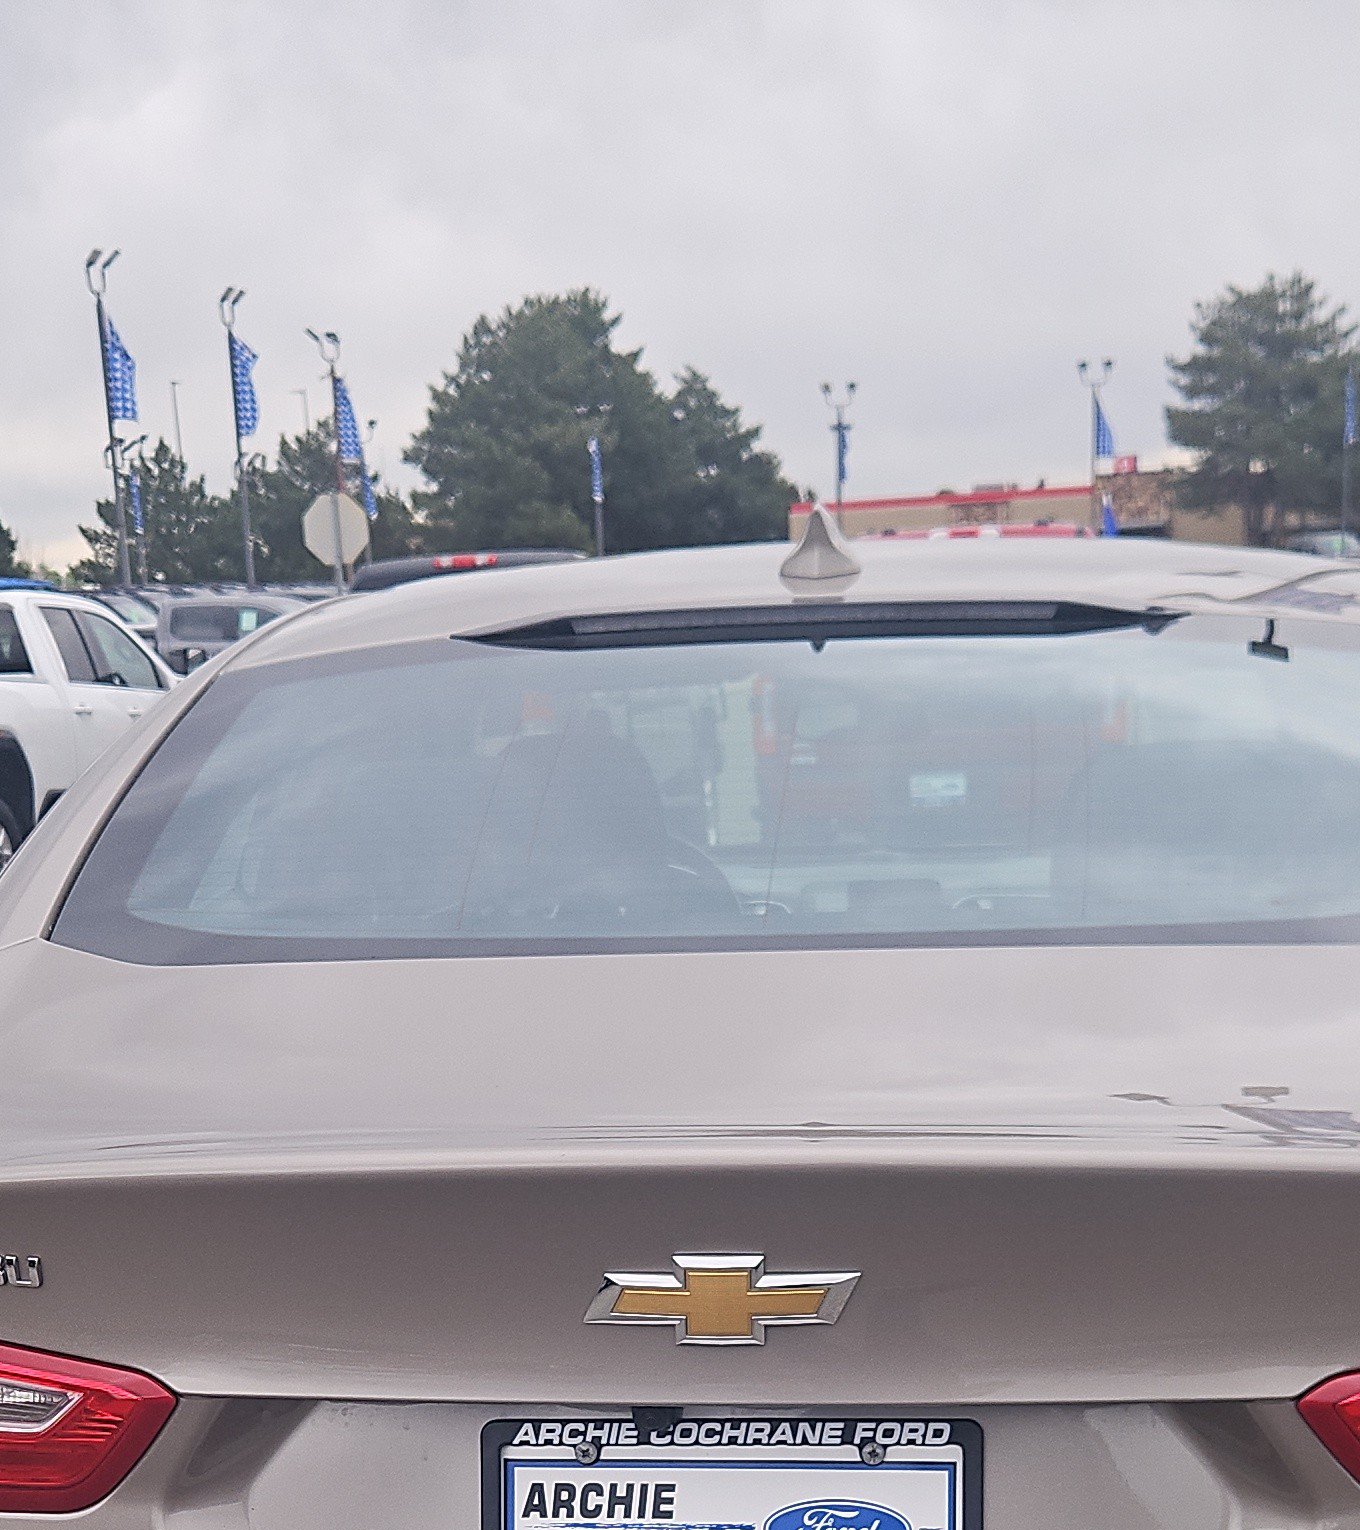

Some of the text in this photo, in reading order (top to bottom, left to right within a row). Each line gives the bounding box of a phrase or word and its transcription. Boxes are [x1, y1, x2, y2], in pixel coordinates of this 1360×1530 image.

[512, 1422, 638, 1445] ARCHIE
[852, 1422, 951, 1446] FORD
[522, 1482, 677, 1519] ARCHIE
